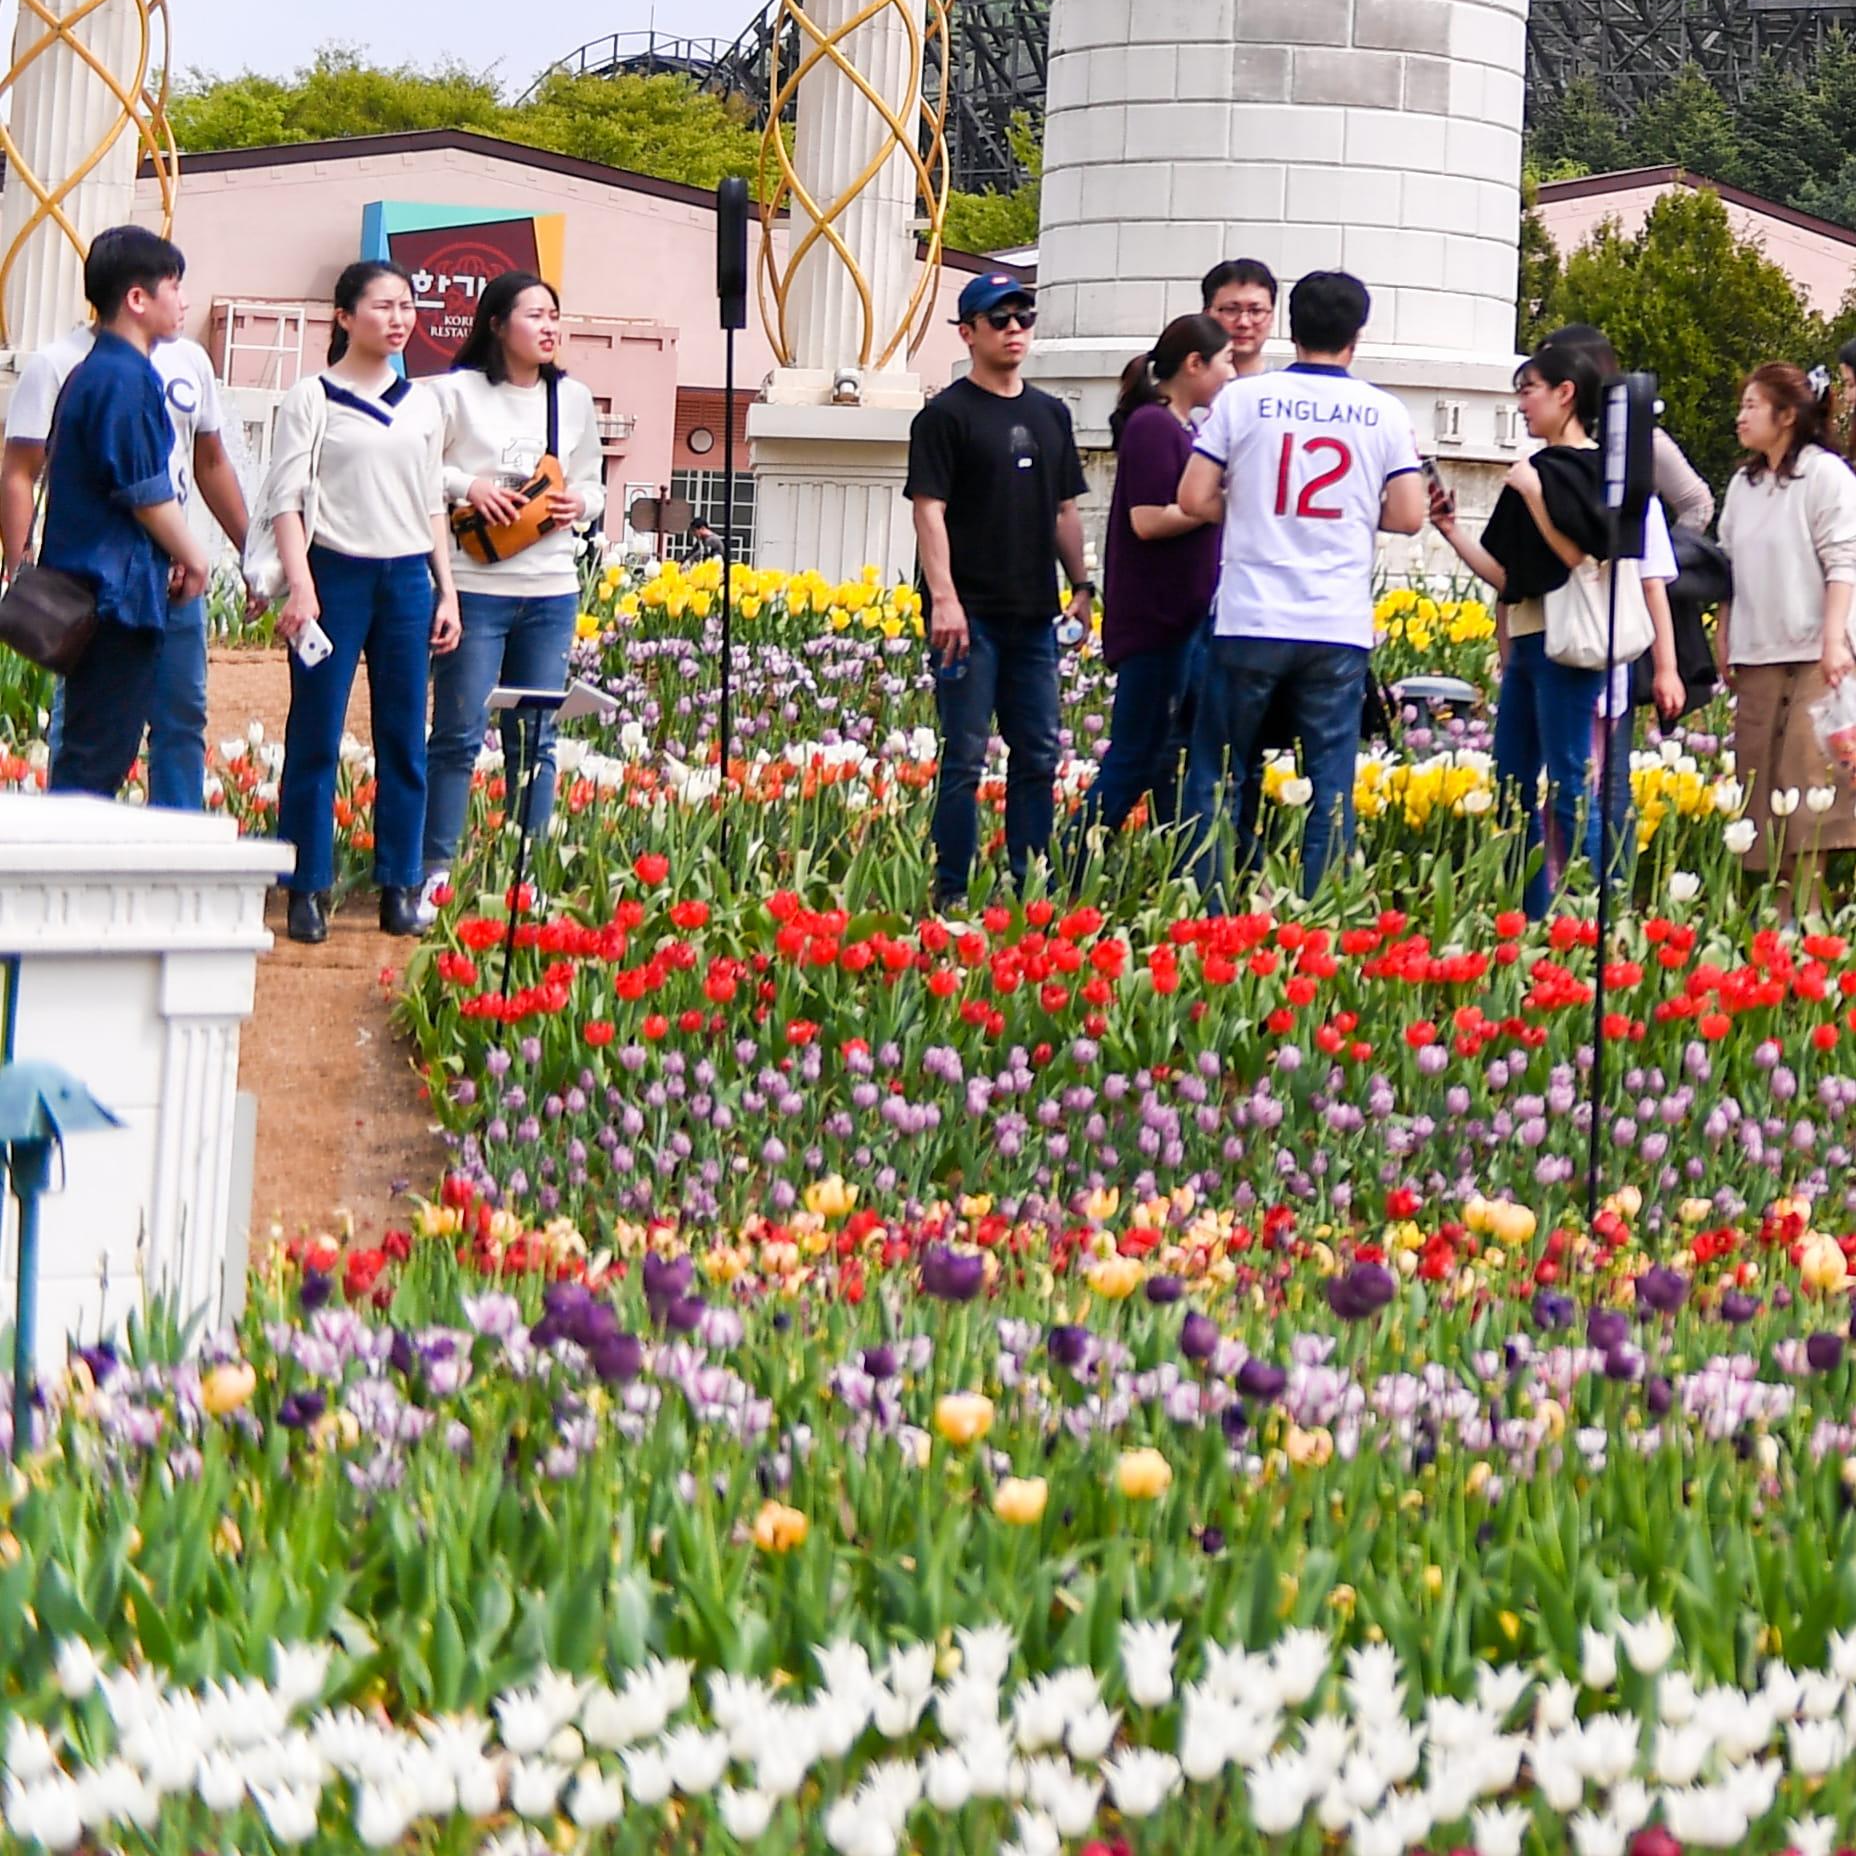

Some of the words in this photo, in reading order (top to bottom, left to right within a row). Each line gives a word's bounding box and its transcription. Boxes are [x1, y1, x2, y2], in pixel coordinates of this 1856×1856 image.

[430, 325, 472, 338] RESTAU
[1258, 397, 1380, 427] ENGLAND
[1274, 432, 1353, 519] 12
